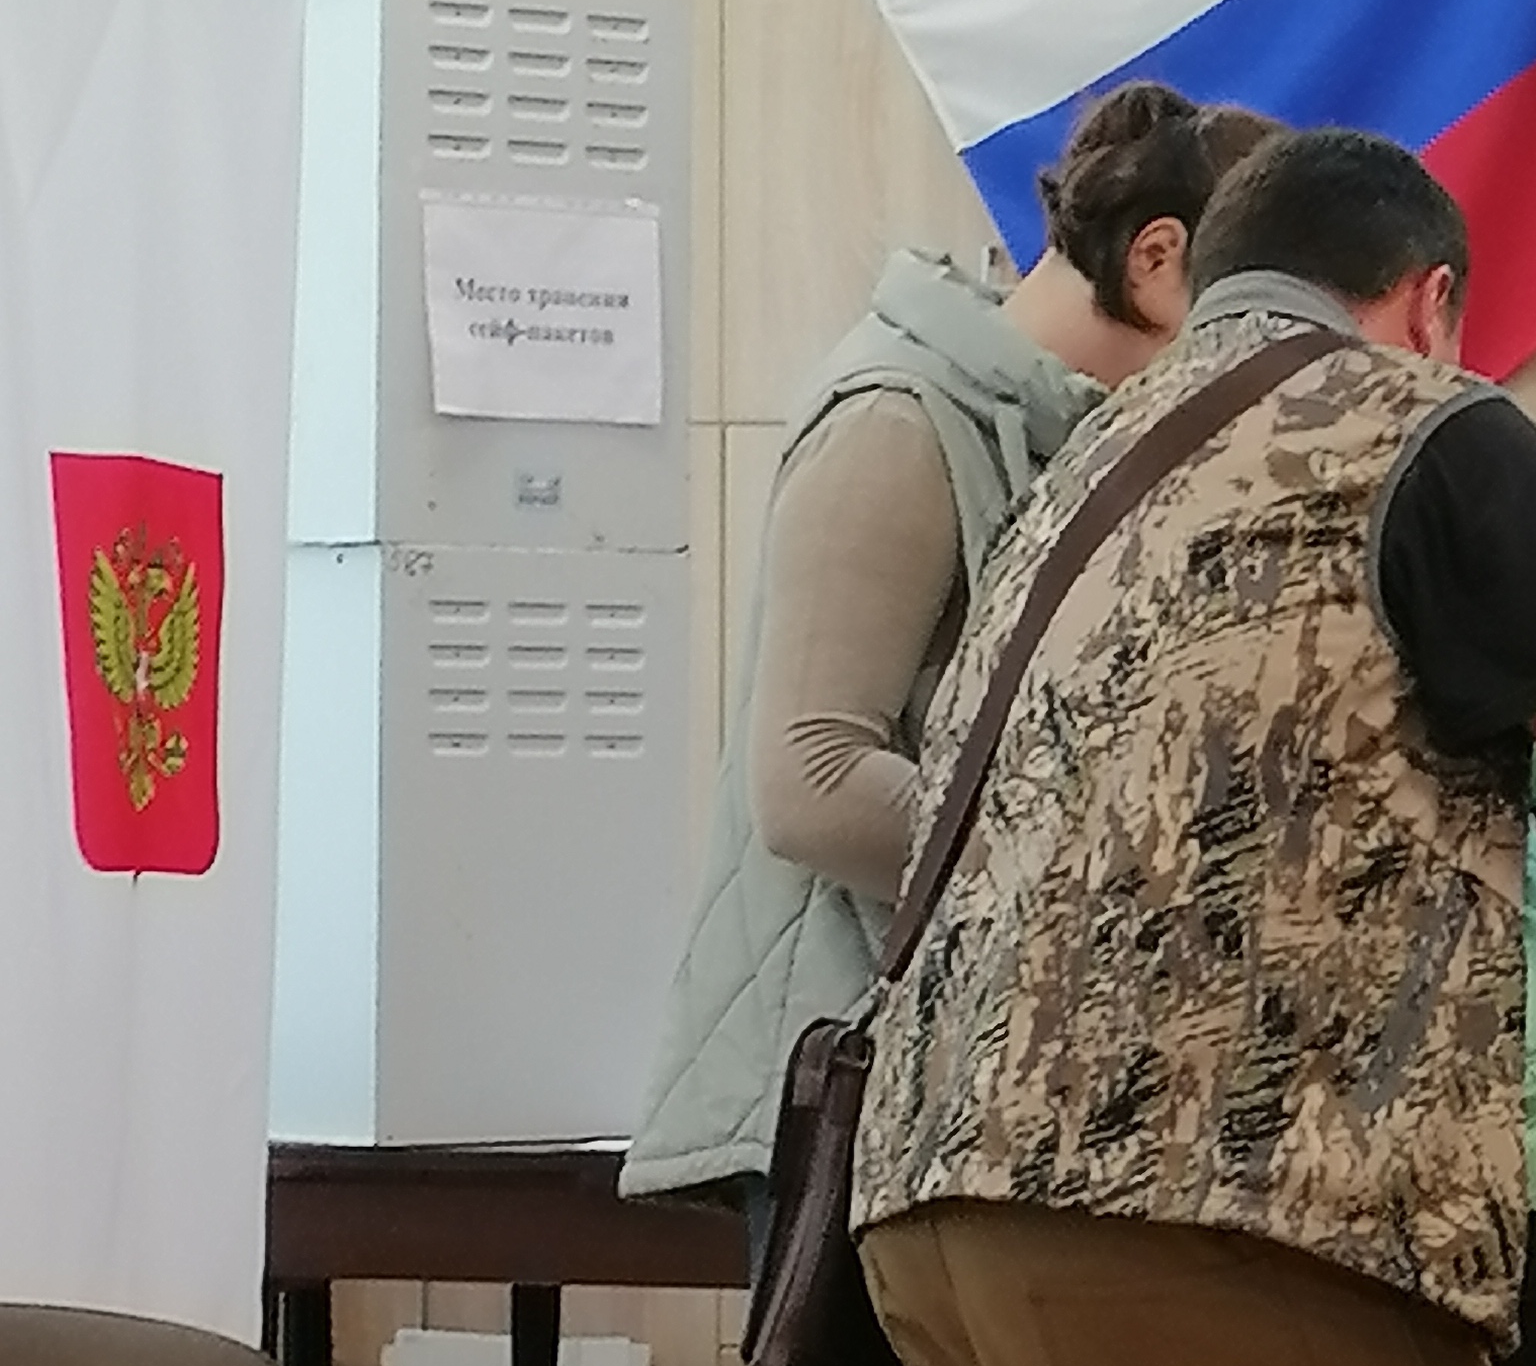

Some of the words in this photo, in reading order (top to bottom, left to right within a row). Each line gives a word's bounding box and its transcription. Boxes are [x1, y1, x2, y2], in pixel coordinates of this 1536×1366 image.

[455, 277, 521, 303] Место
[527, 288, 629, 311] хранения
[468, 318, 615, 346] сейф-пакетов
